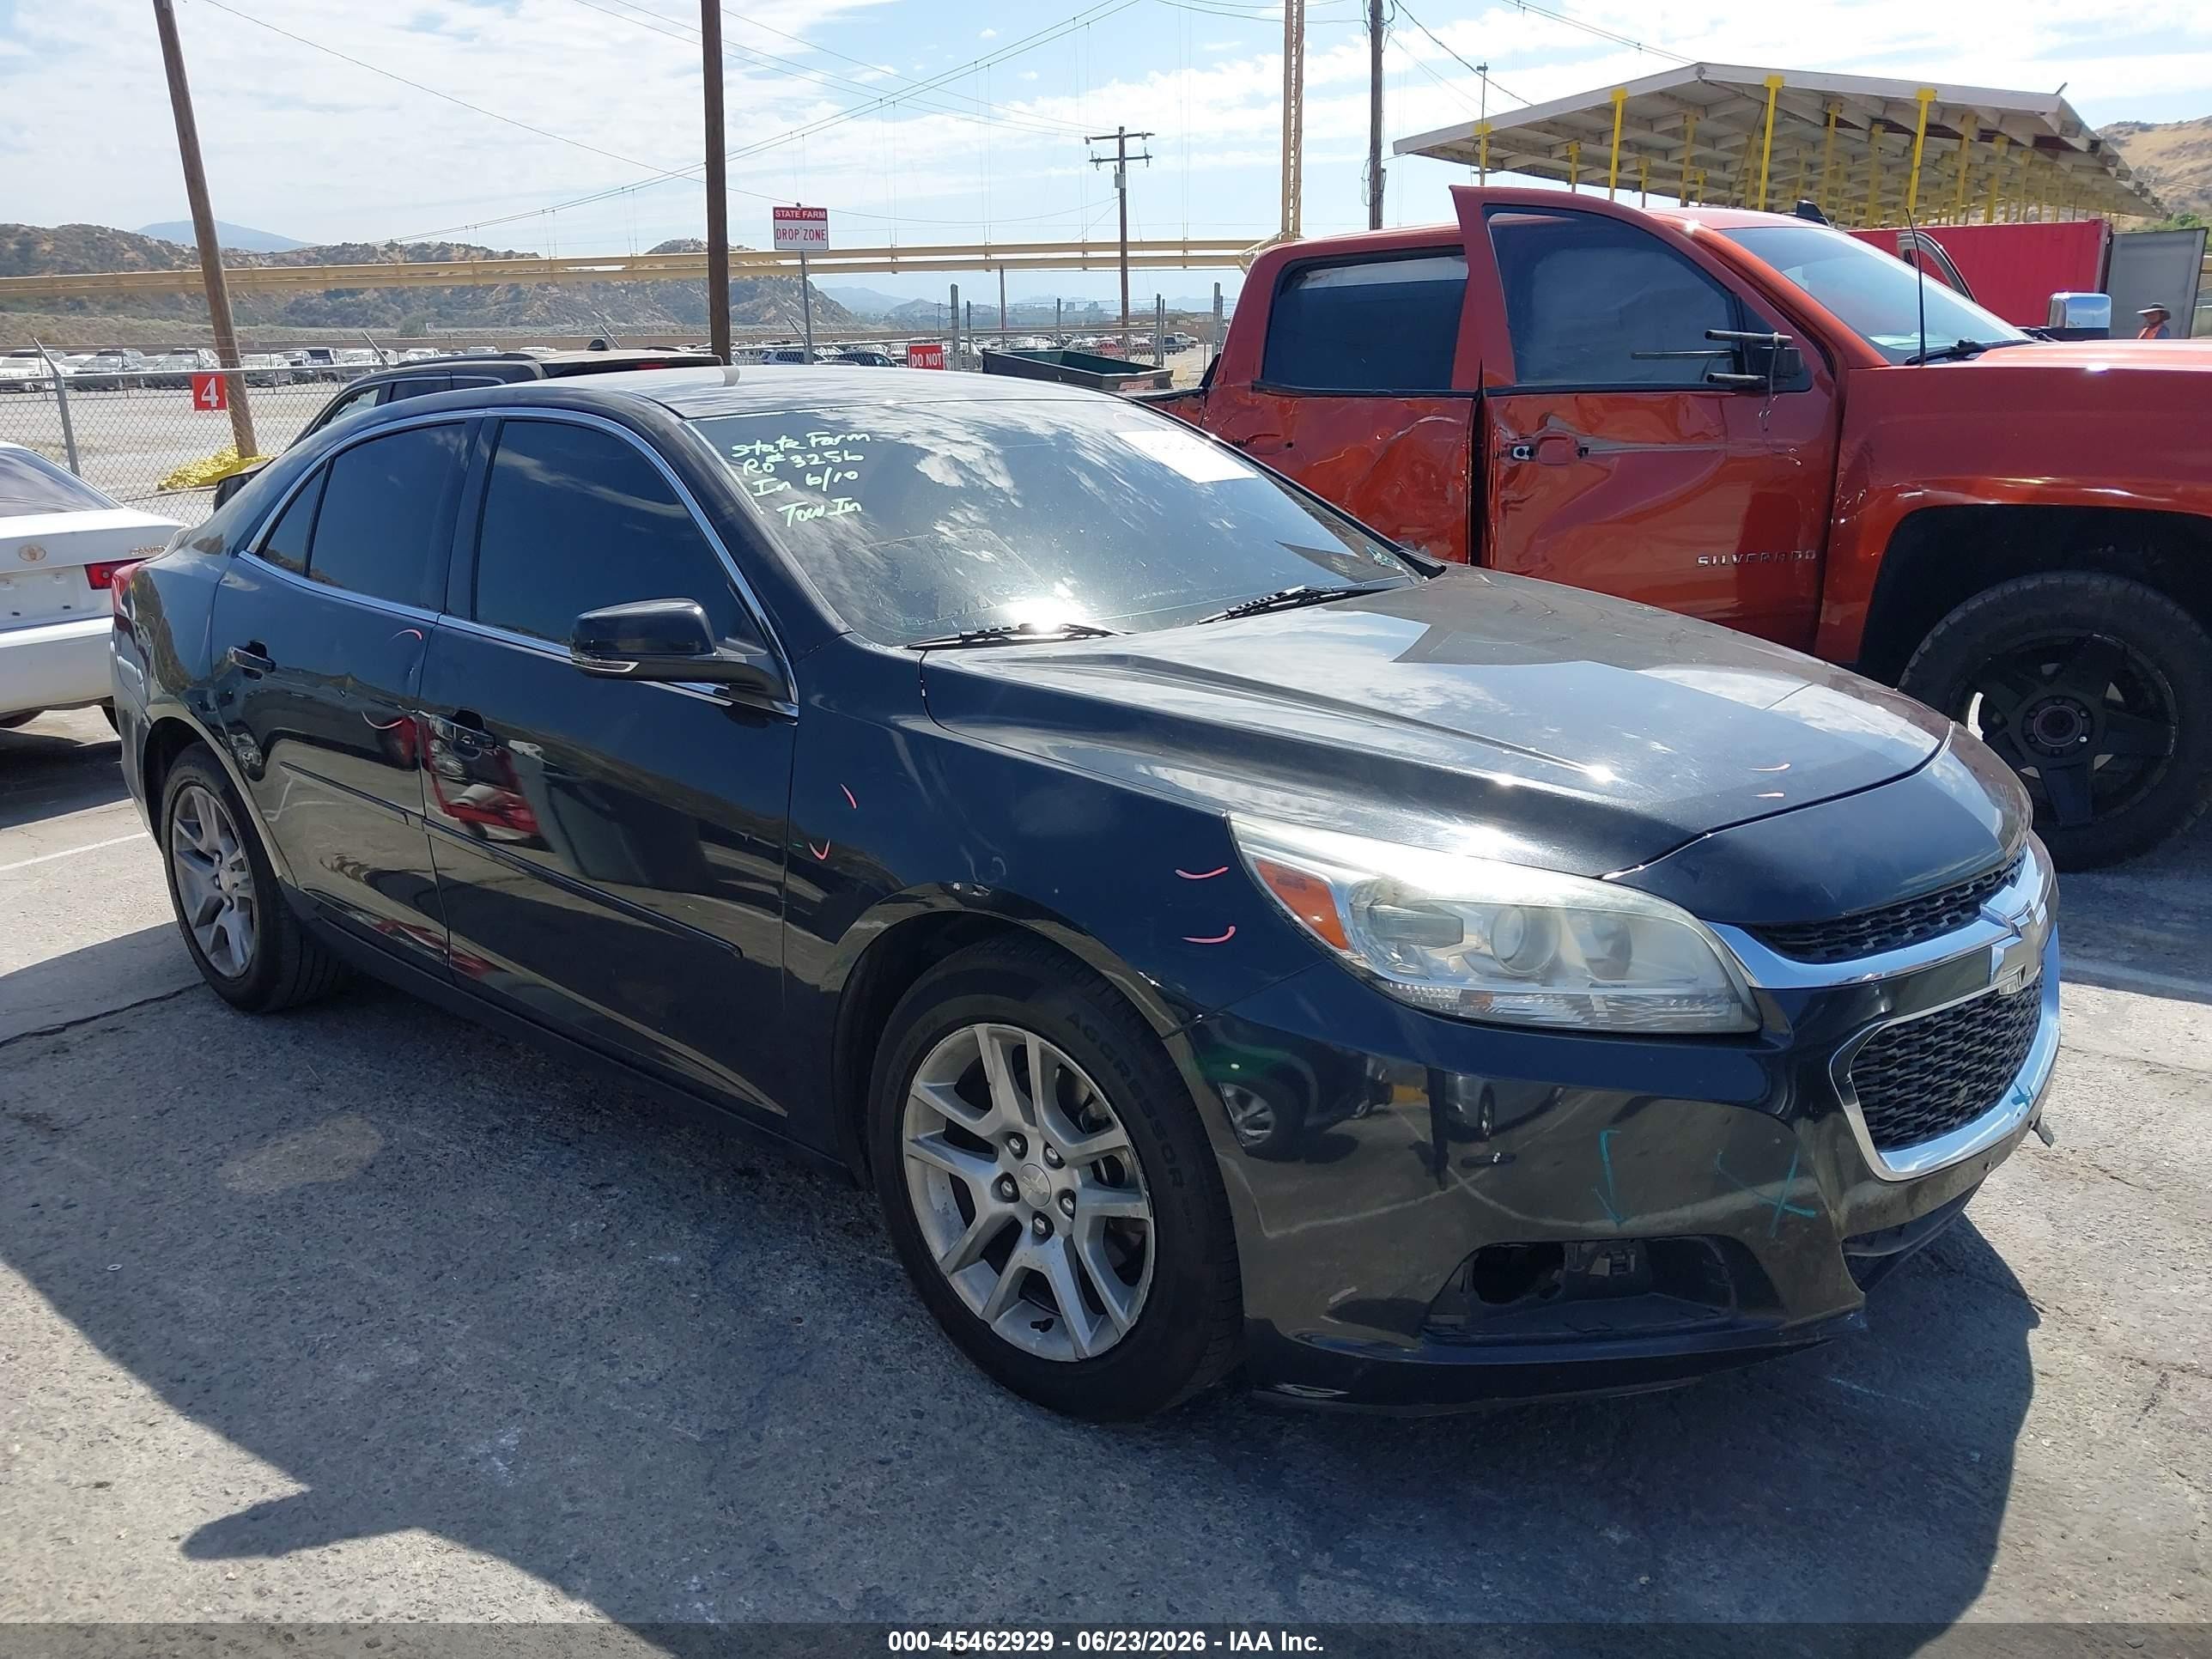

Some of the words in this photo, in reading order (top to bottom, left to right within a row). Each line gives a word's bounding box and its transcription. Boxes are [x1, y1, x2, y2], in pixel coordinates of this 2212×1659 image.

[775, 210, 801, 218] STATE
[802, 210, 826, 219] FARM
[776, 228, 799, 240] DROP
[803, 228, 826, 241] ZONE
[911, 353, 924, 368] DO
[926, 352, 942, 367] NOT
[201, 377, 219, 407] 4
[805, 431, 871, 448] Farm
[751, 477, 793, 496] In
[805, 466, 859, 492] 6/10
[827, 496, 863, 515] In
[1696, 549, 1817, 568] SILVERADO
